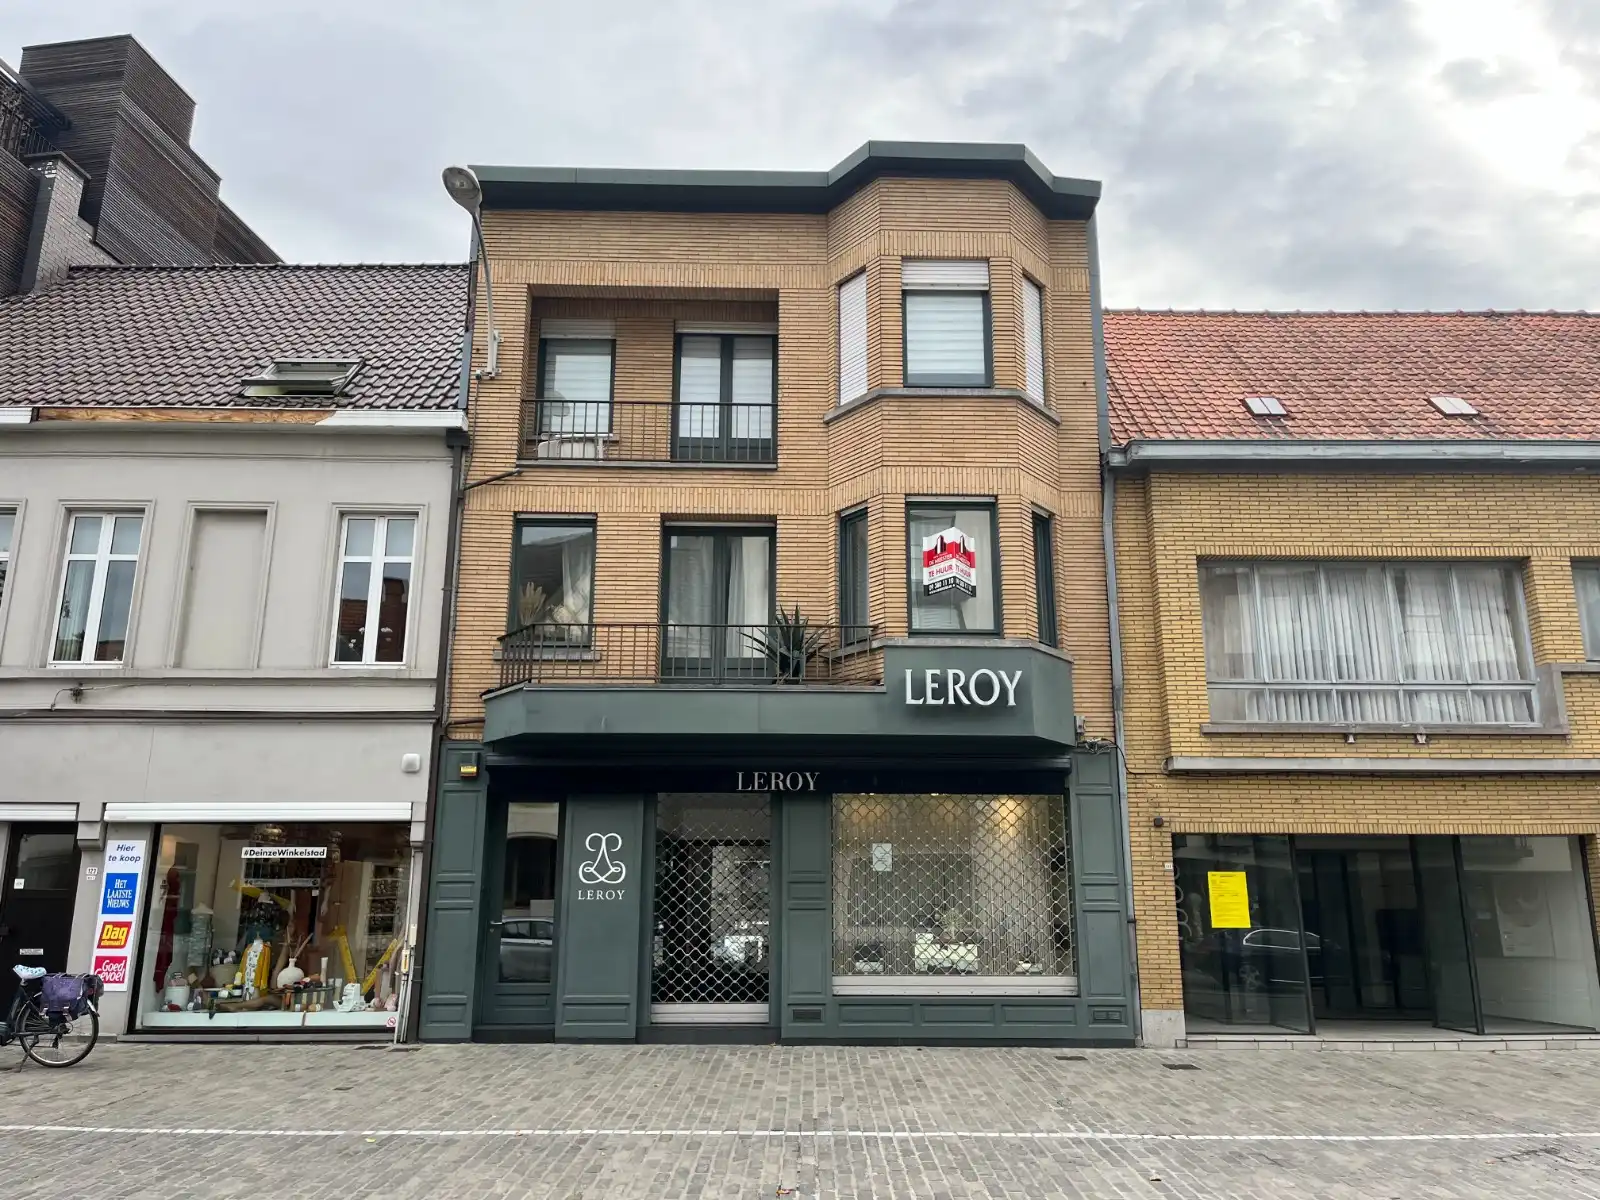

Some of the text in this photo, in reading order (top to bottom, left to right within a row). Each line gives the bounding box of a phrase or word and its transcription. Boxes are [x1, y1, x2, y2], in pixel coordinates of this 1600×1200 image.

[936, 565, 953, 575] HUUR
[905, 668, 1023, 706] LEROY
[736, 771, 820, 791] LEROY
[116, 844, 136, 852] Hier
[243, 848, 325, 857] #DeinzeWinkelstad
[120, 854, 141, 863] koop
[577, 889, 625, 901] LEROY
[101, 924, 128, 946] Dag
[102, 960, 126, 972] Goed
